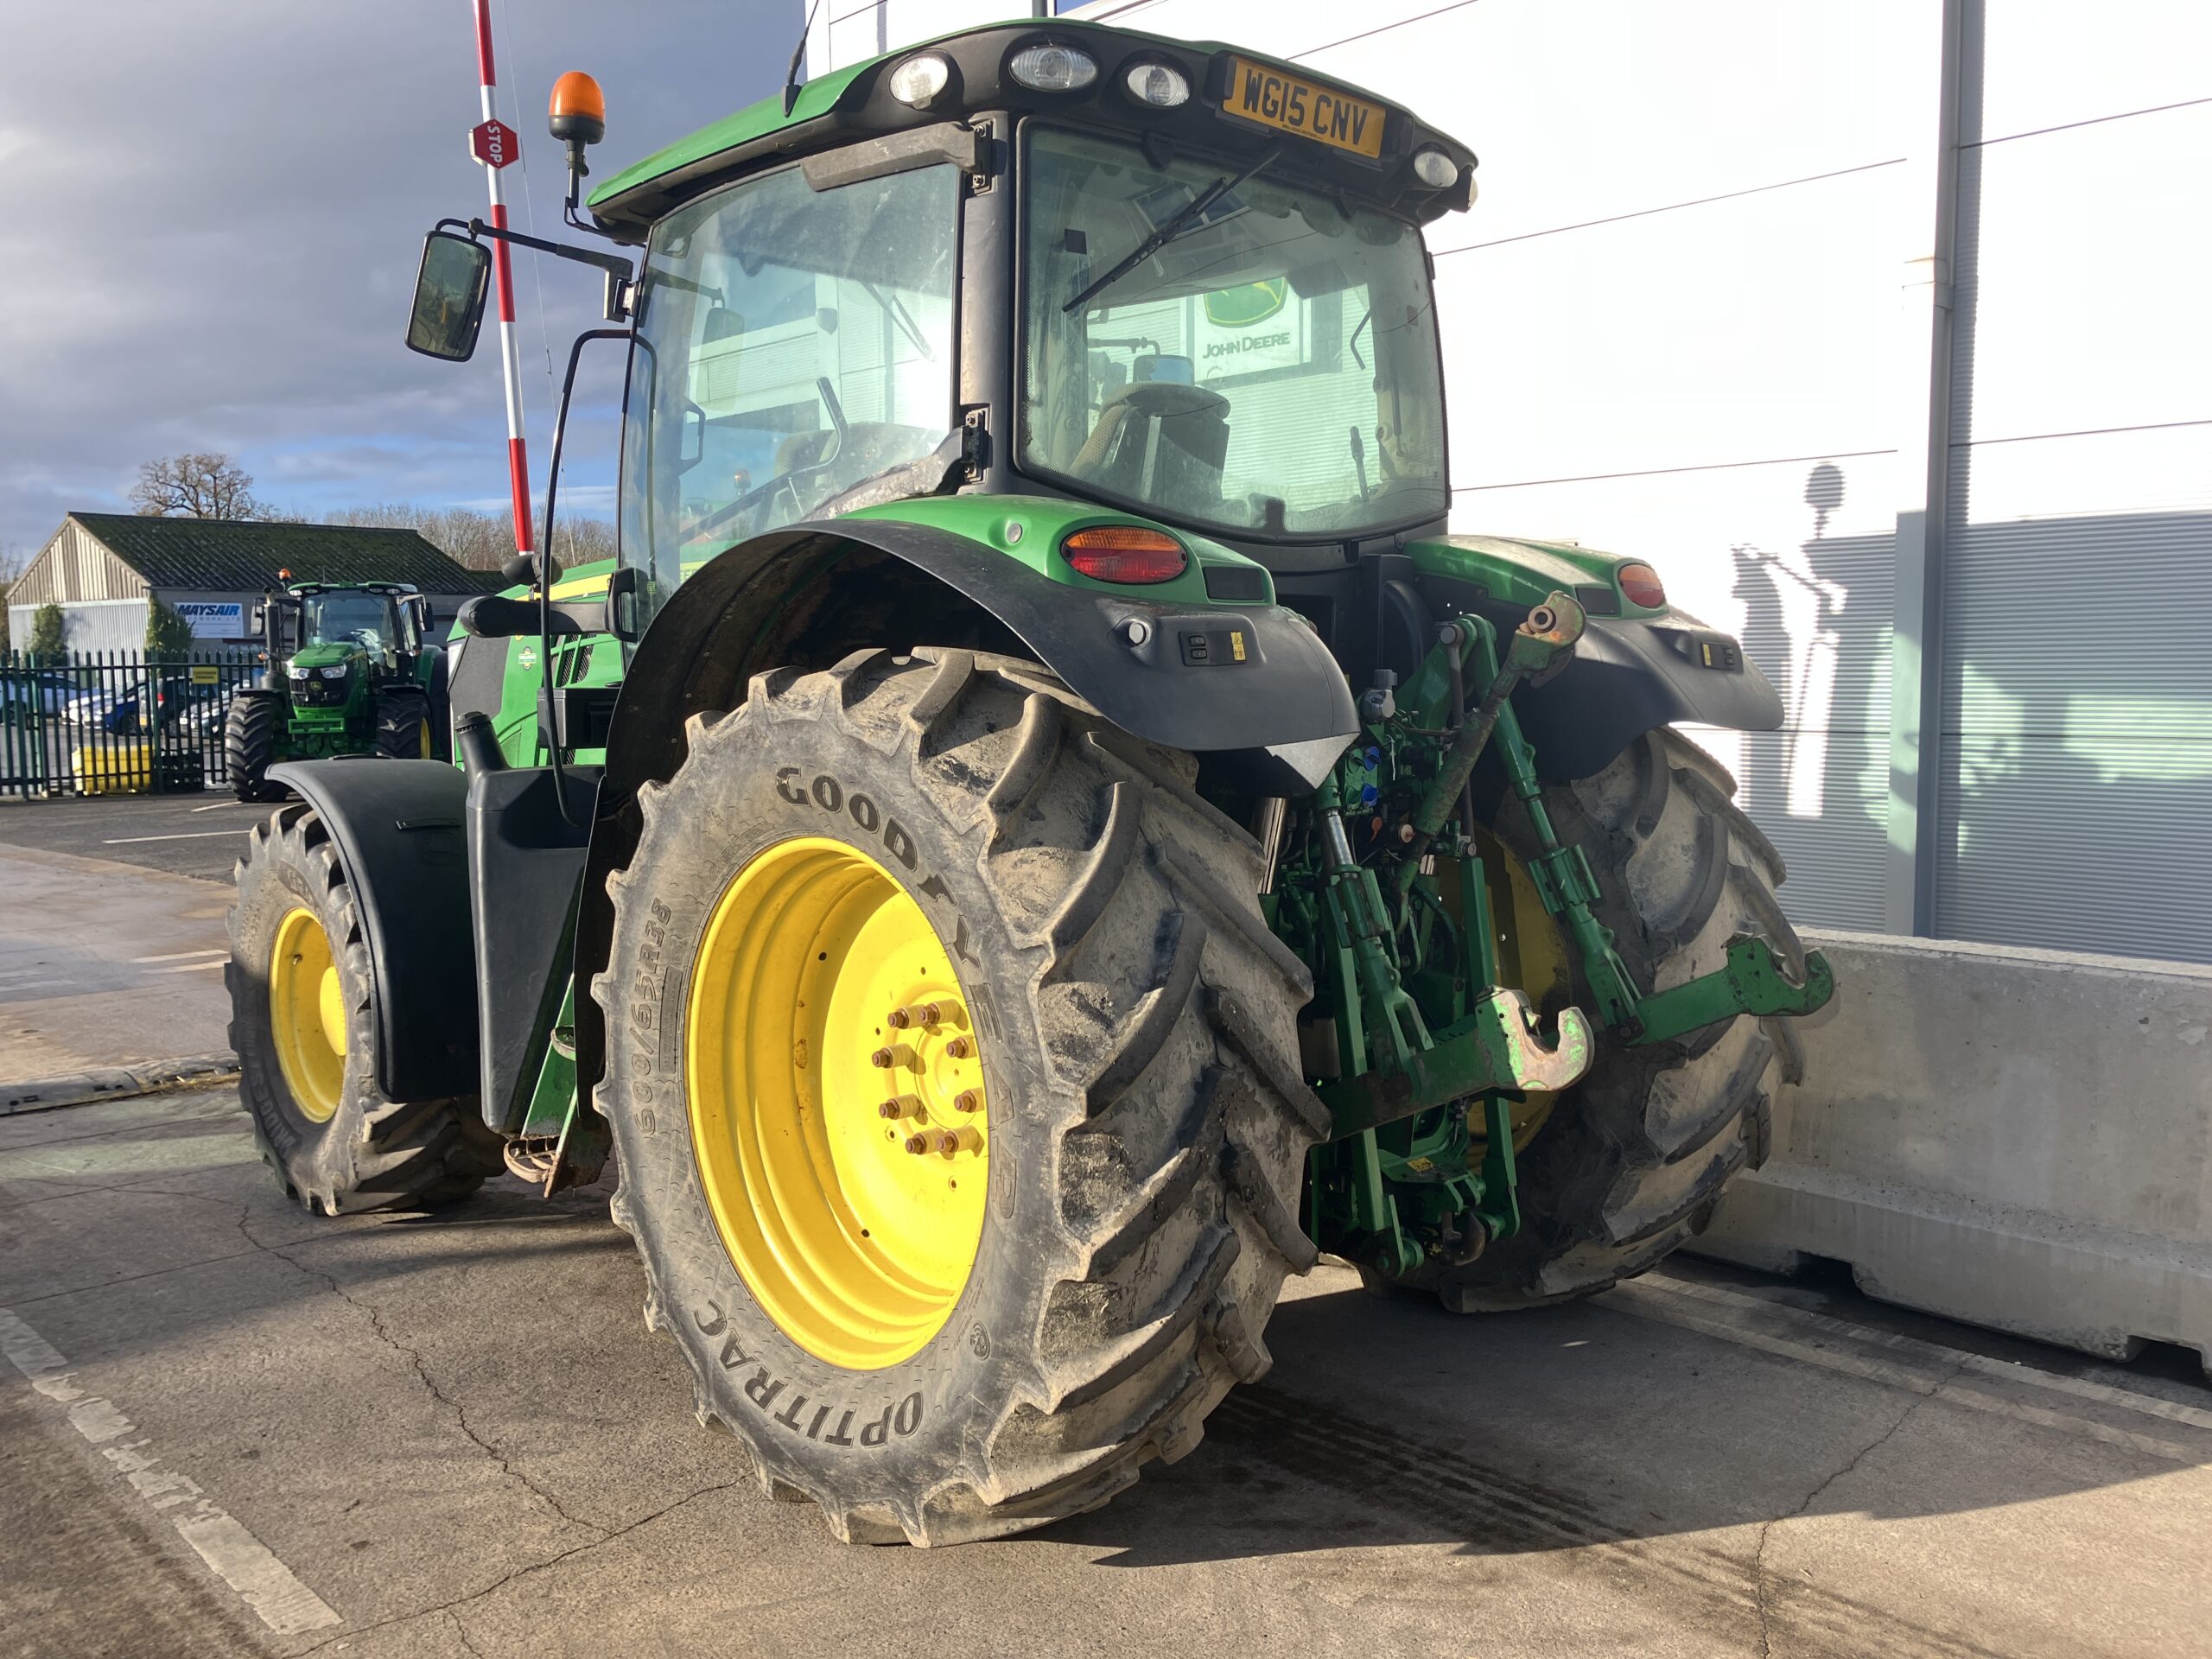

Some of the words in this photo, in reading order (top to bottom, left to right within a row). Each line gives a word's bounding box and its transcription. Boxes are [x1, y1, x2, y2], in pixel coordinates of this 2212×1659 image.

[1243, 69, 1308, 127] WG15
[1313, 94, 1369, 146] CNV
[487, 125, 503, 163] STOP
[1202, 340, 1241, 359] JOHN
[1242, 332, 1291, 352] DEERE
[177, 605, 240, 616] MAYSAIR
[629, 898, 671, 1135] 600/65R38
[694, 1300, 924, 1449] OPTITRAC
